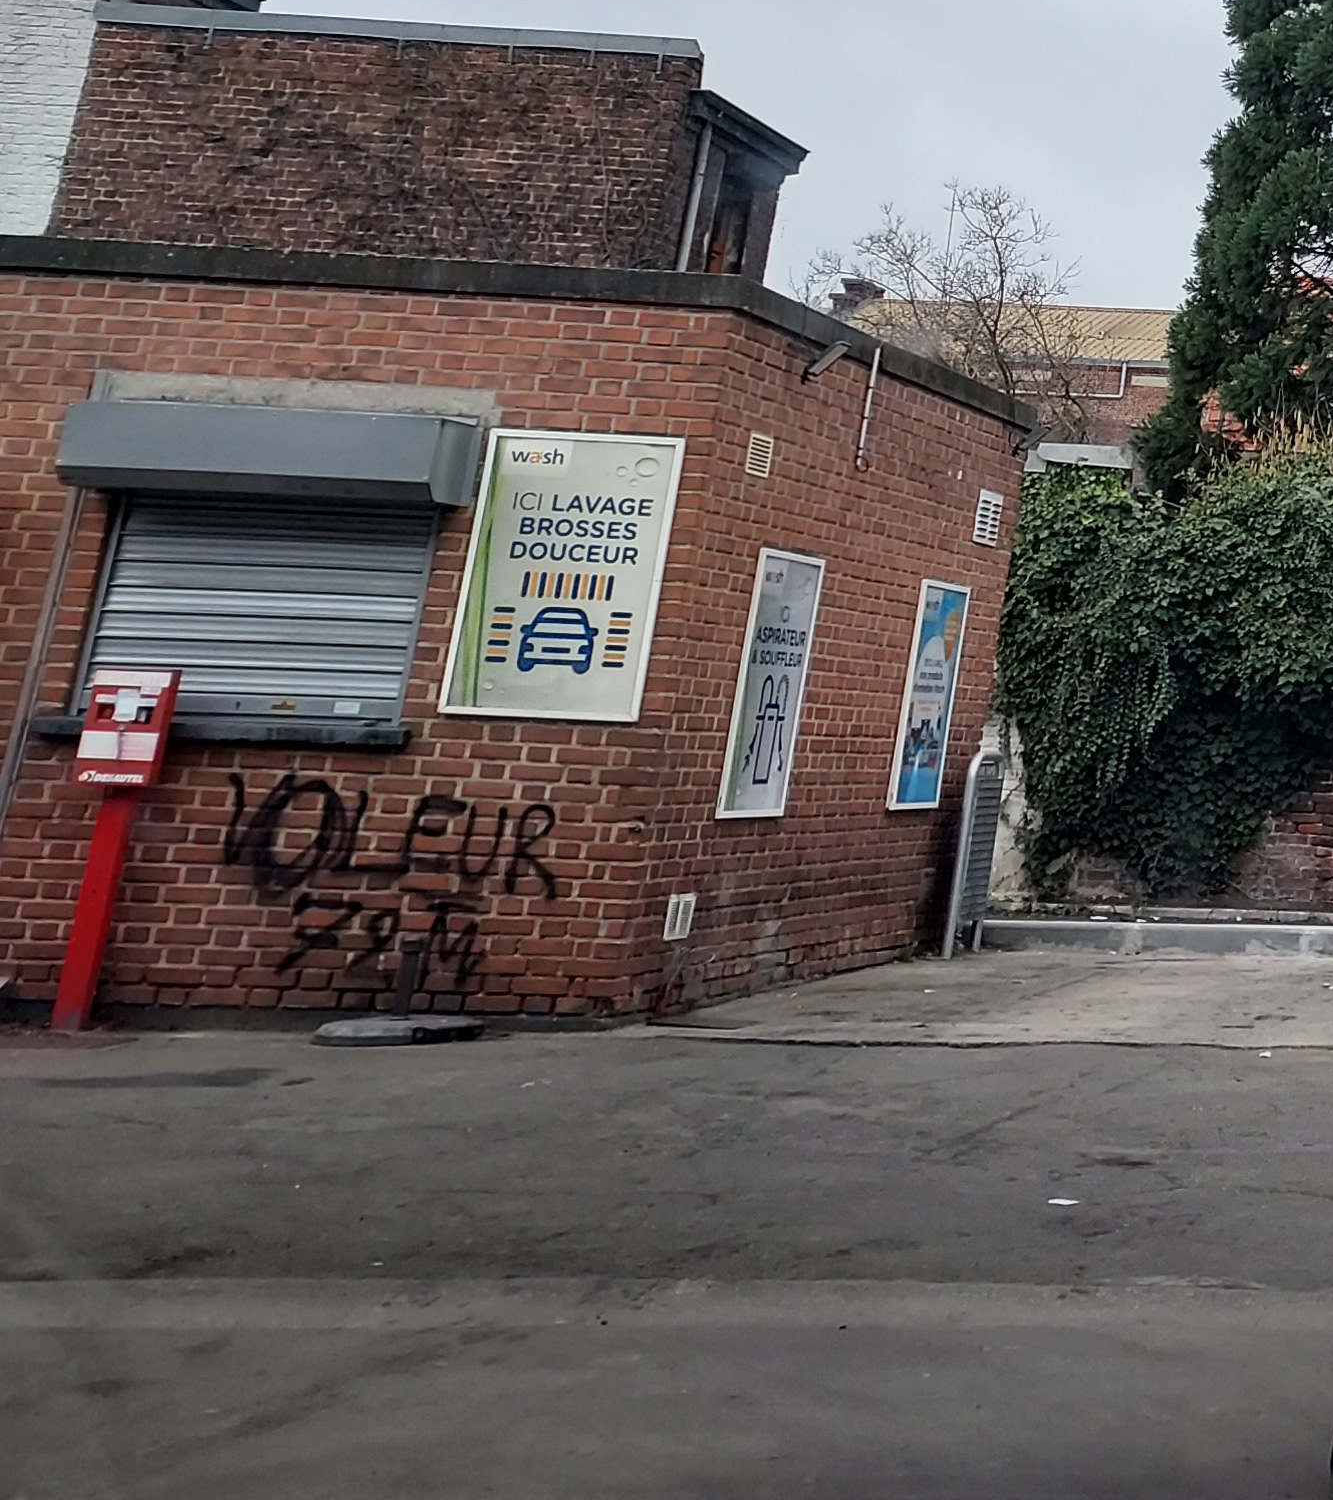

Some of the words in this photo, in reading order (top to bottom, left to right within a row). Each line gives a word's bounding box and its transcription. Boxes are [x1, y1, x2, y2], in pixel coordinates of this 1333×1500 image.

[512, 448, 564, 465] wash
[512, 492, 542, 511] ICI
[551, 494, 654, 517] LAVAGE
[519, 516, 638, 540] BROSSES
[509, 541, 639, 565] DOUCEUR
[756, 626, 806, 647] ASPIRATEUR
[759, 650, 802, 668] SOUFFLEUR
[225, 773, 556, 900] VOLEUR
